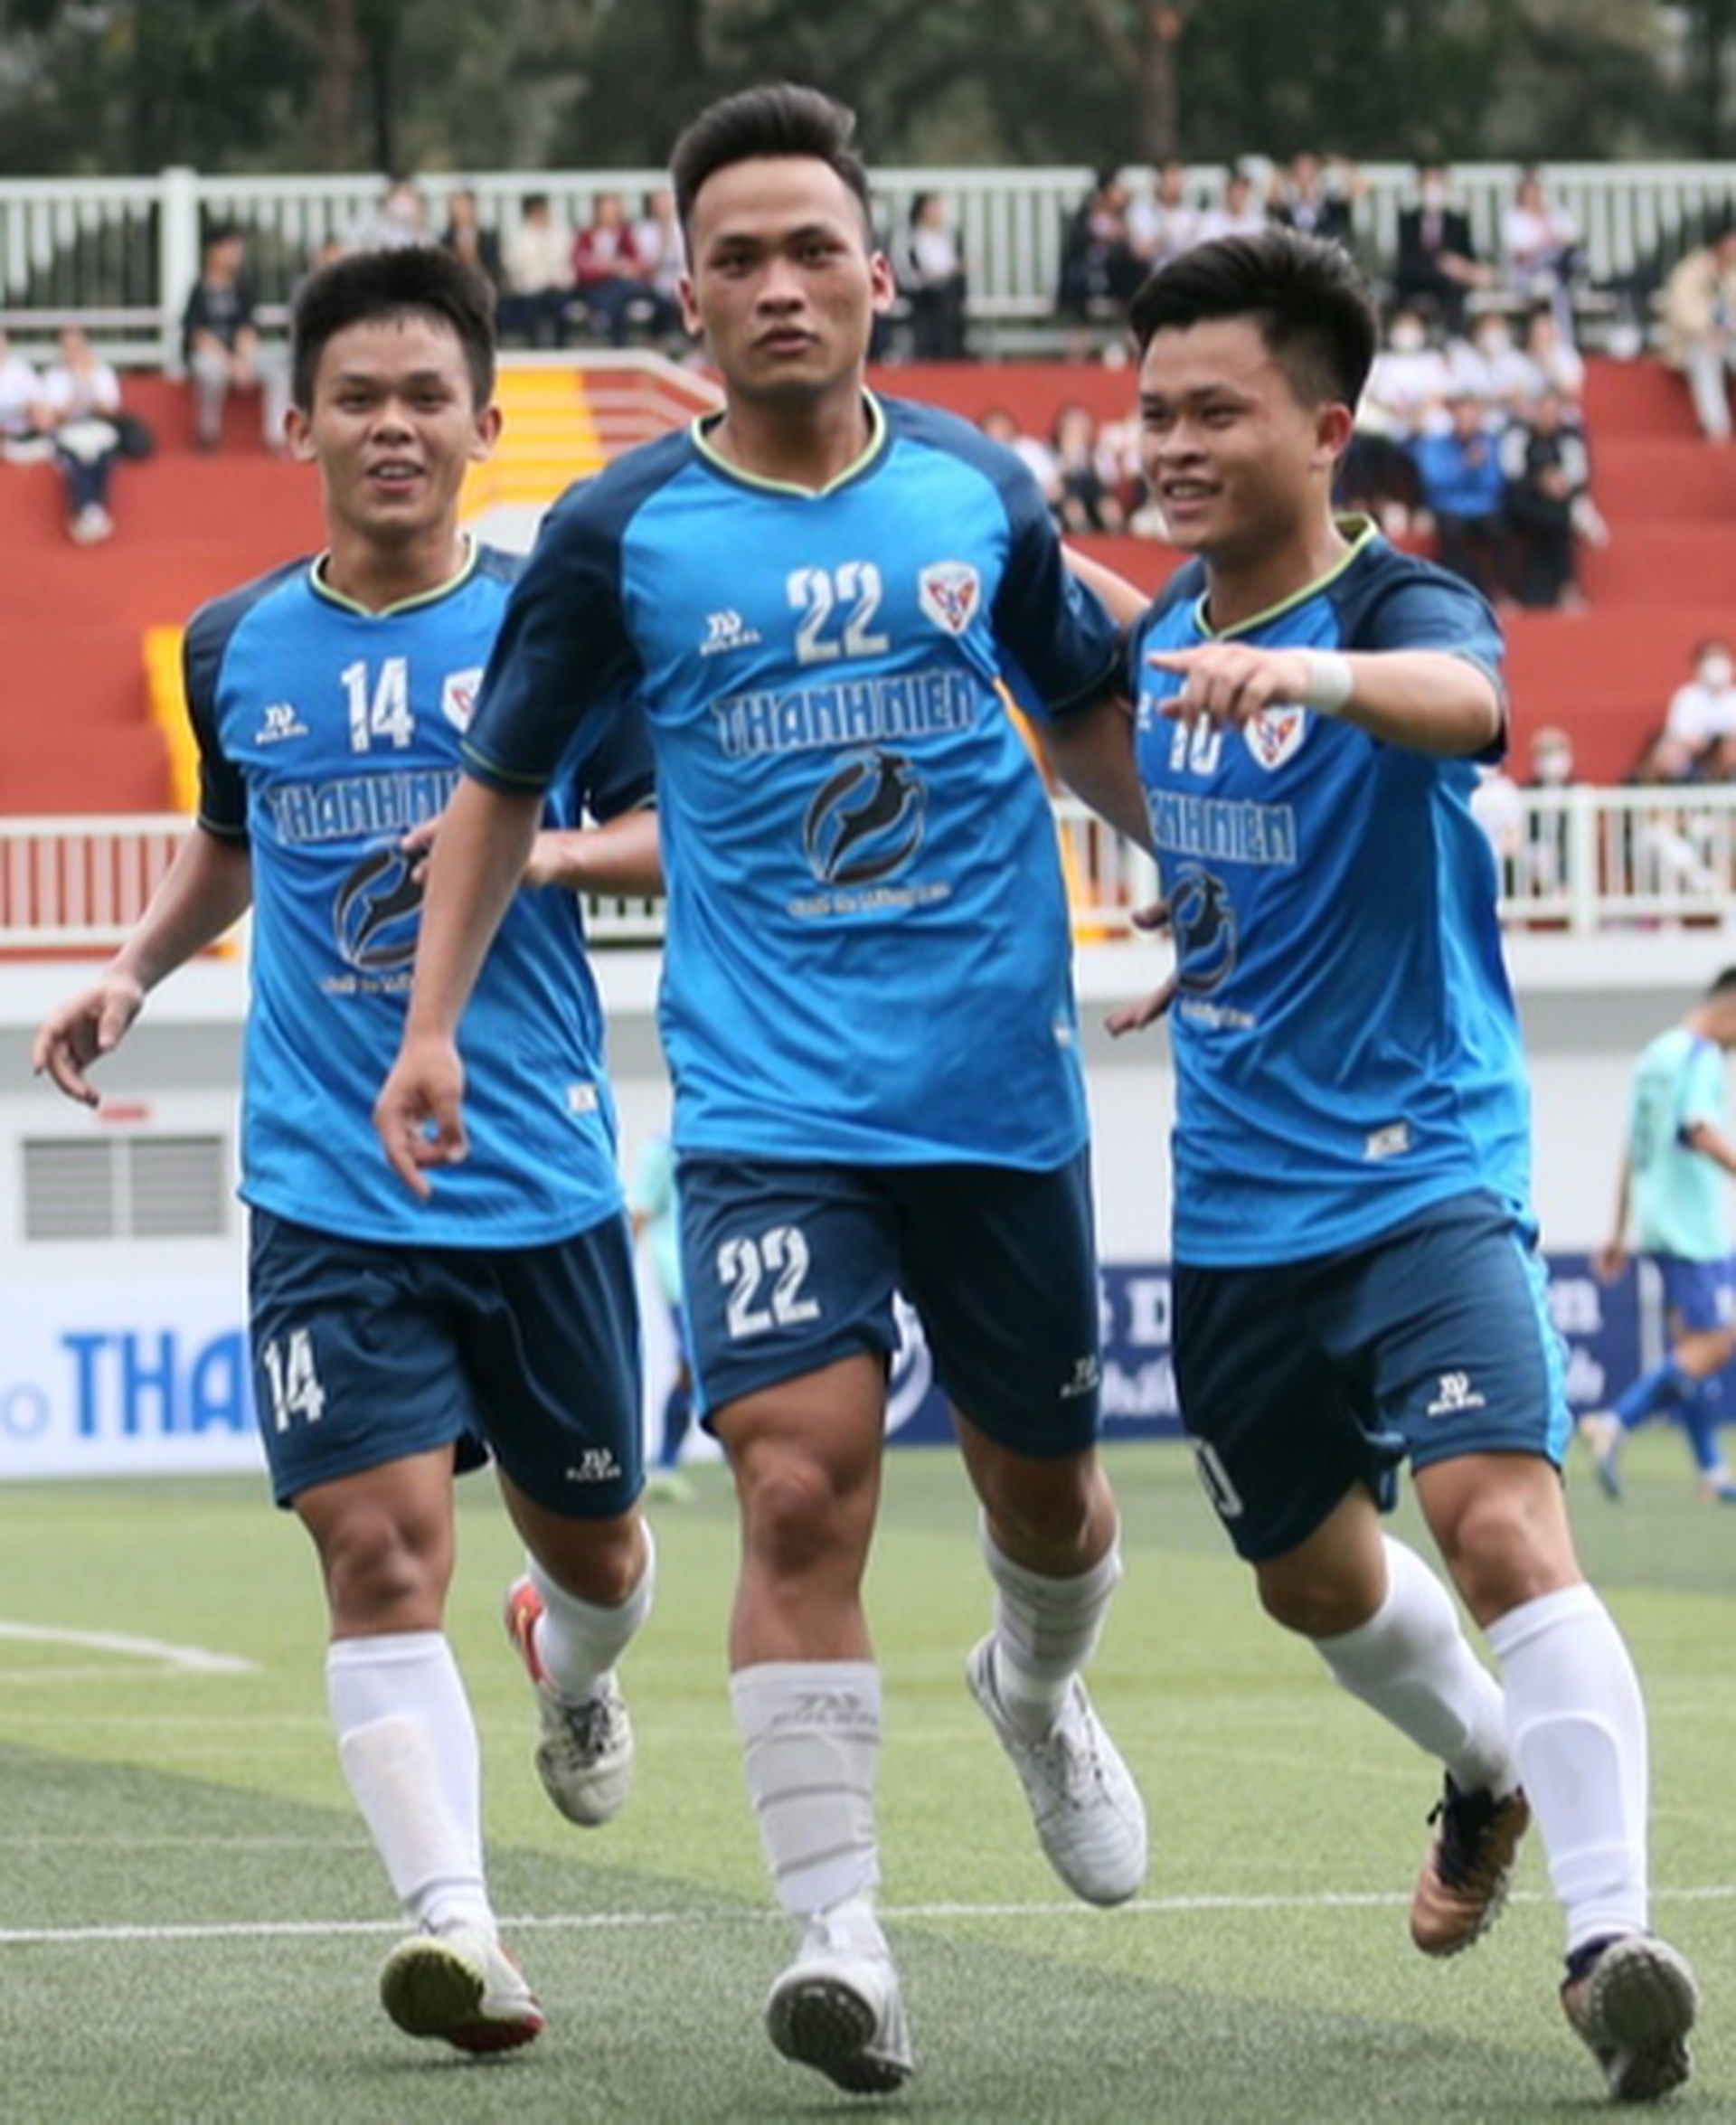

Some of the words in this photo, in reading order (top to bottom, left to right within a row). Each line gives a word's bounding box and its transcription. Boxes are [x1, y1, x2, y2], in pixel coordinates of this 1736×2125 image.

[786, 561, 889, 665] 22
[341, 657, 416, 752] 14
[717, 1225, 820, 1339] 22
[264, 1328, 326, 1434] 14
